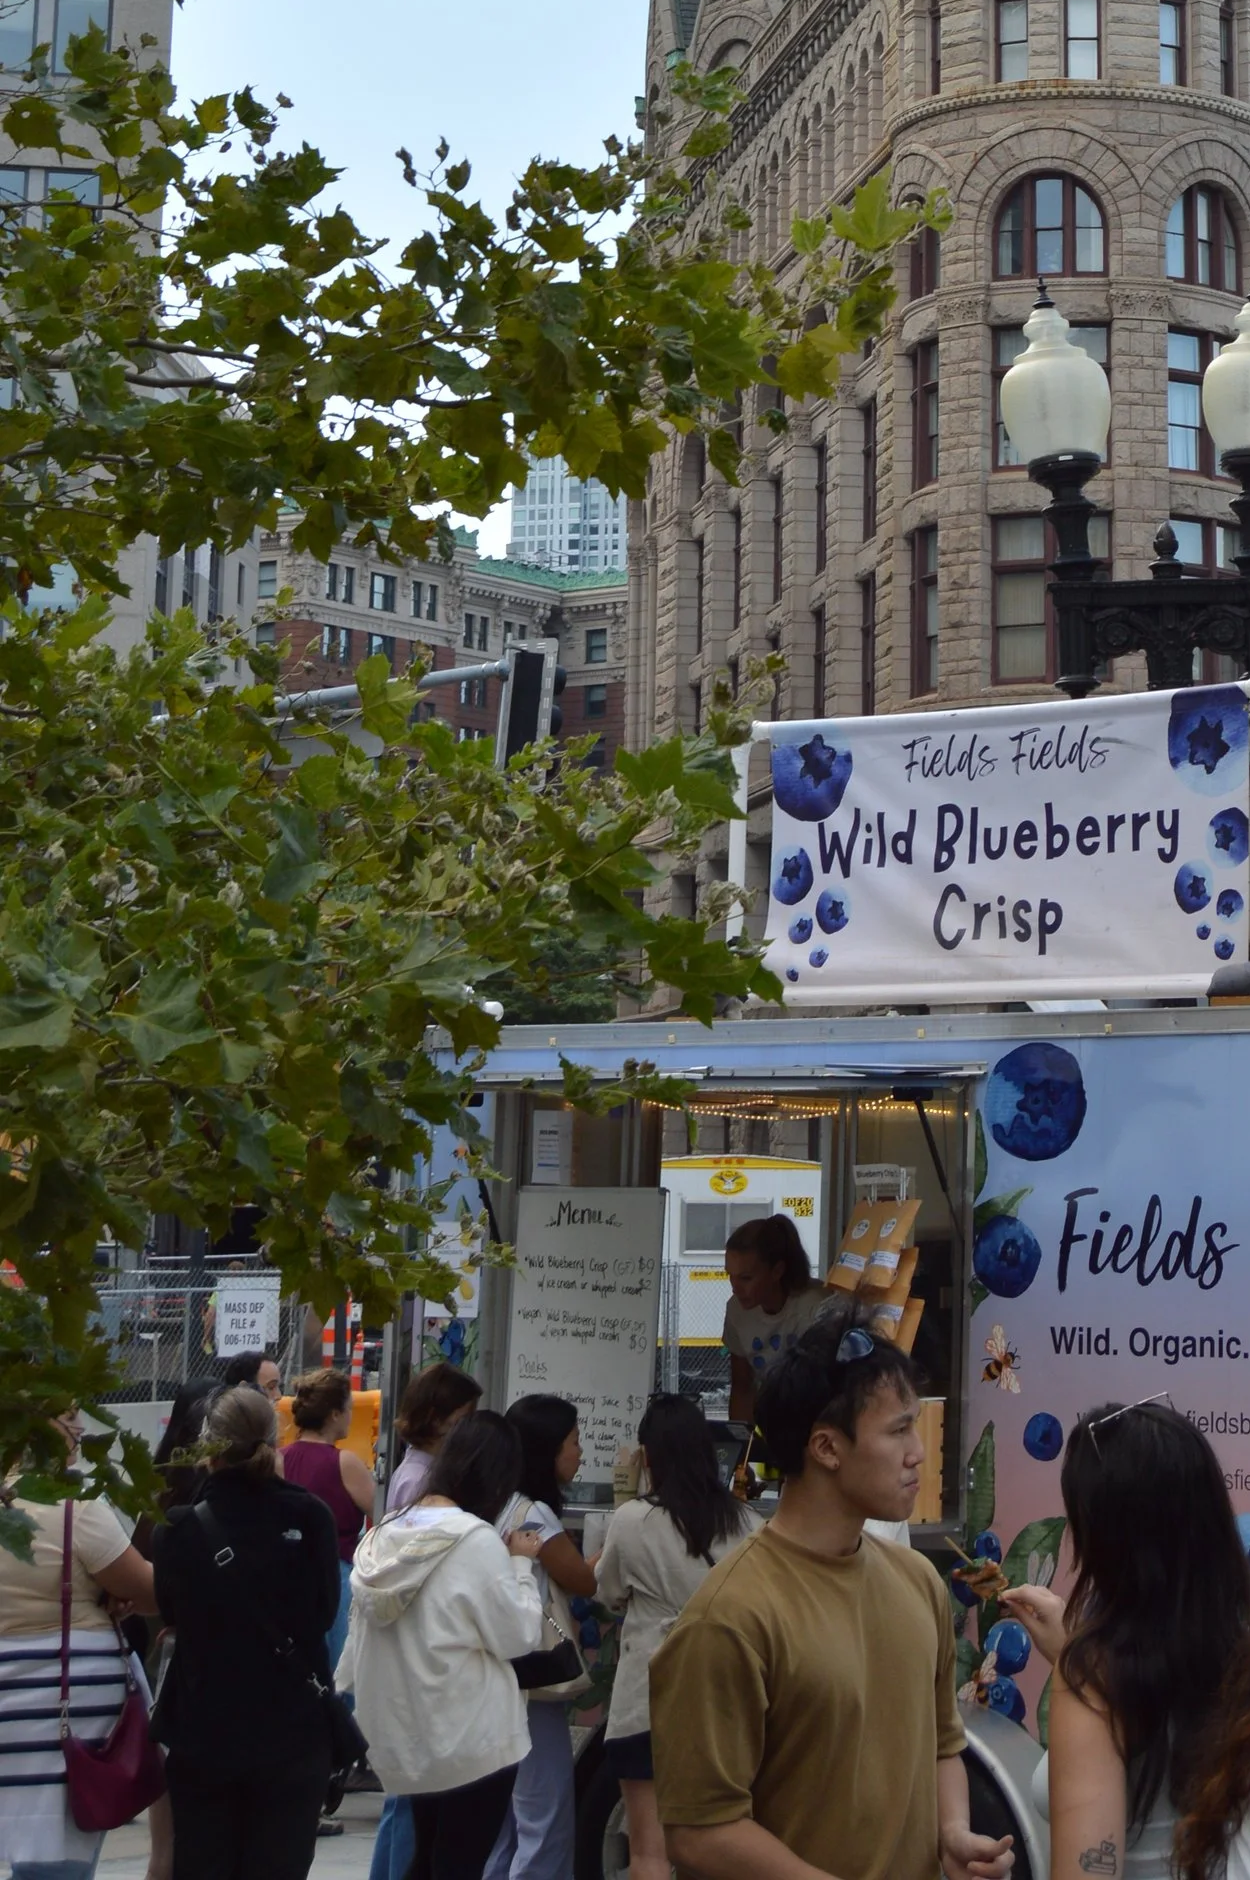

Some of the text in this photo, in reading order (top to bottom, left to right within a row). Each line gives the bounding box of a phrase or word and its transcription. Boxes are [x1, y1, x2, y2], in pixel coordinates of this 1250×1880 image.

[902, 724, 1110, 783] Fields Fields
[818, 802, 1180, 879] Wild Blueberry
[932, 883, 1064, 956] Crisp
[556, 1199, 603, 1226] Menu
[1057, 1186, 1240, 1296] Fields
[548, 1255, 585, 1276] Blueberry
[224, 1302, 265, 1314] MASS DEP
[230, 1318, 257, 1329] FILE #
[224, 1333, 261, 1345] 006-1735
[1050, 1326, 1119, 1356] Wild.
[1129, 1327, 1250, 1365] Organic.
